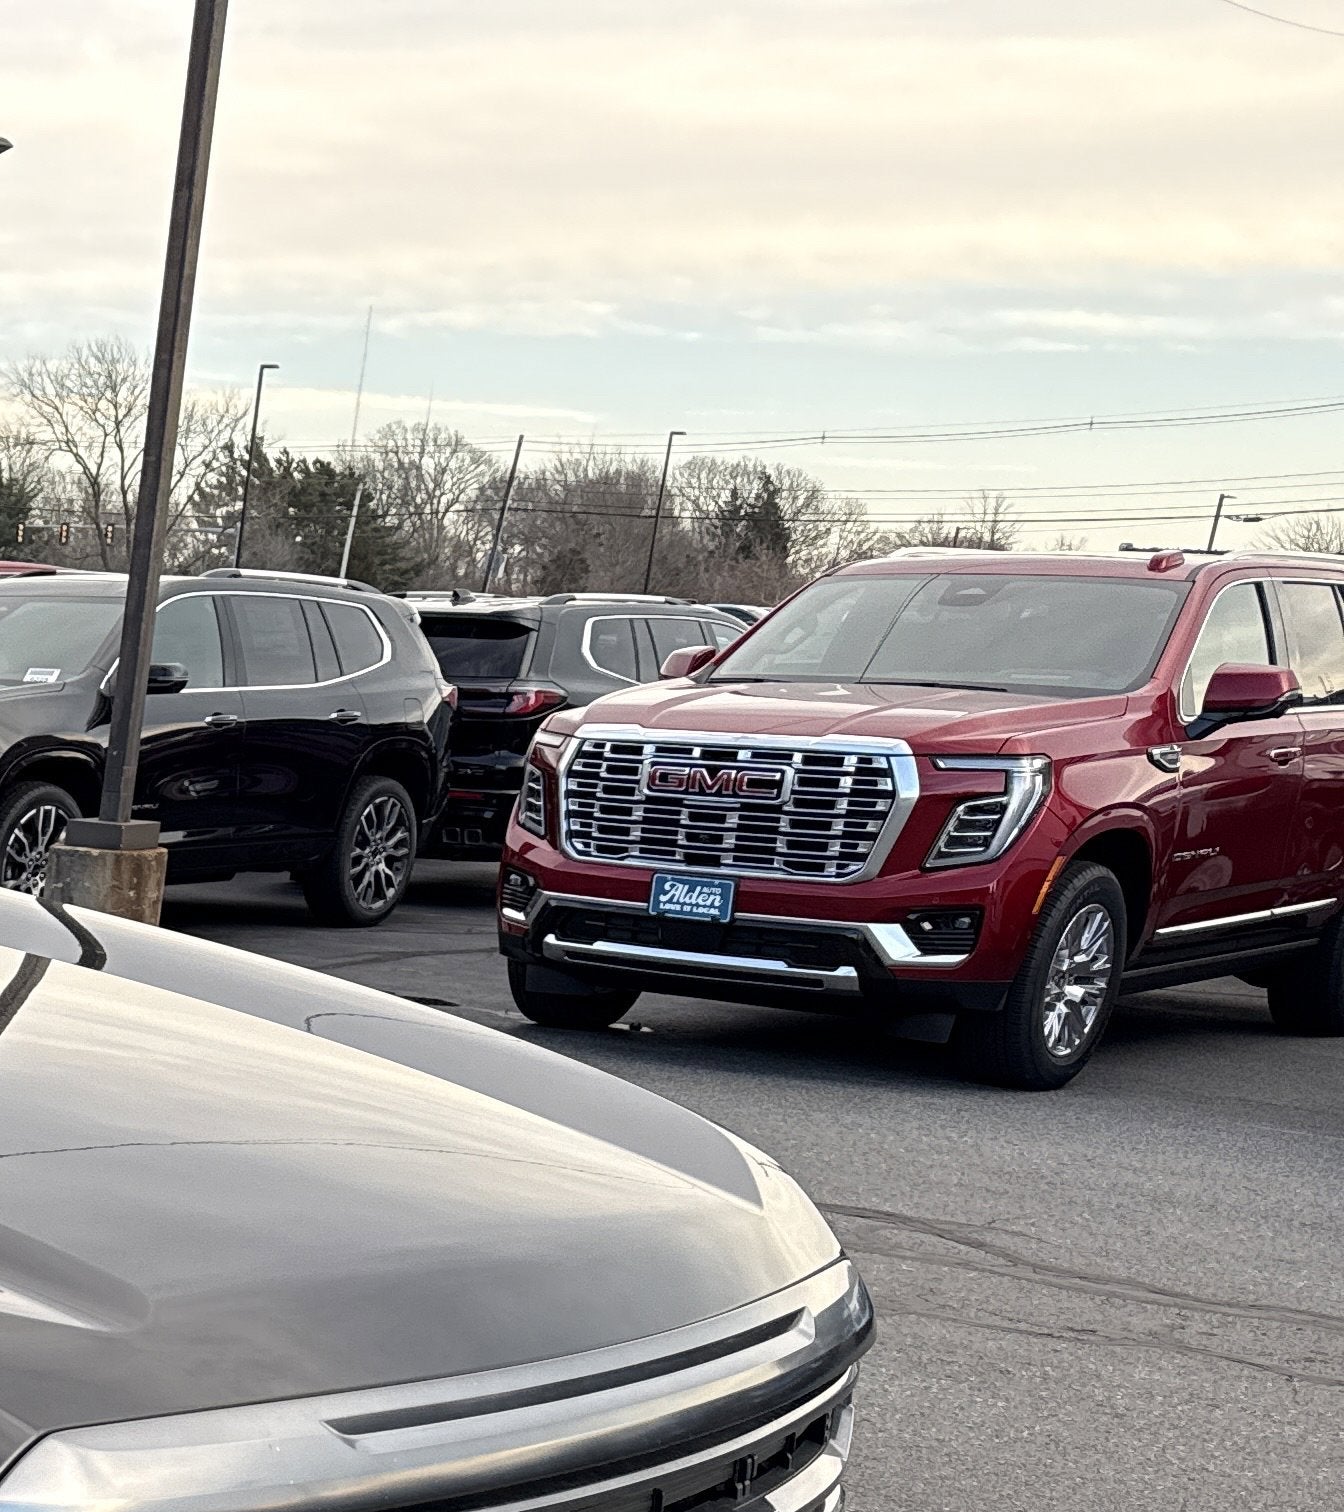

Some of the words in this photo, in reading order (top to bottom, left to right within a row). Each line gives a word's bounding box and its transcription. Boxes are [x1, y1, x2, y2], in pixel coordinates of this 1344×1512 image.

[649, 765, 781, 797] GMC
[659, 881, 723, 906] Alden
[701, 886, 722, 894] AUTO
[659, 902, 681, 910] LOVE
[692, 906, 720, 914] LOCAL
